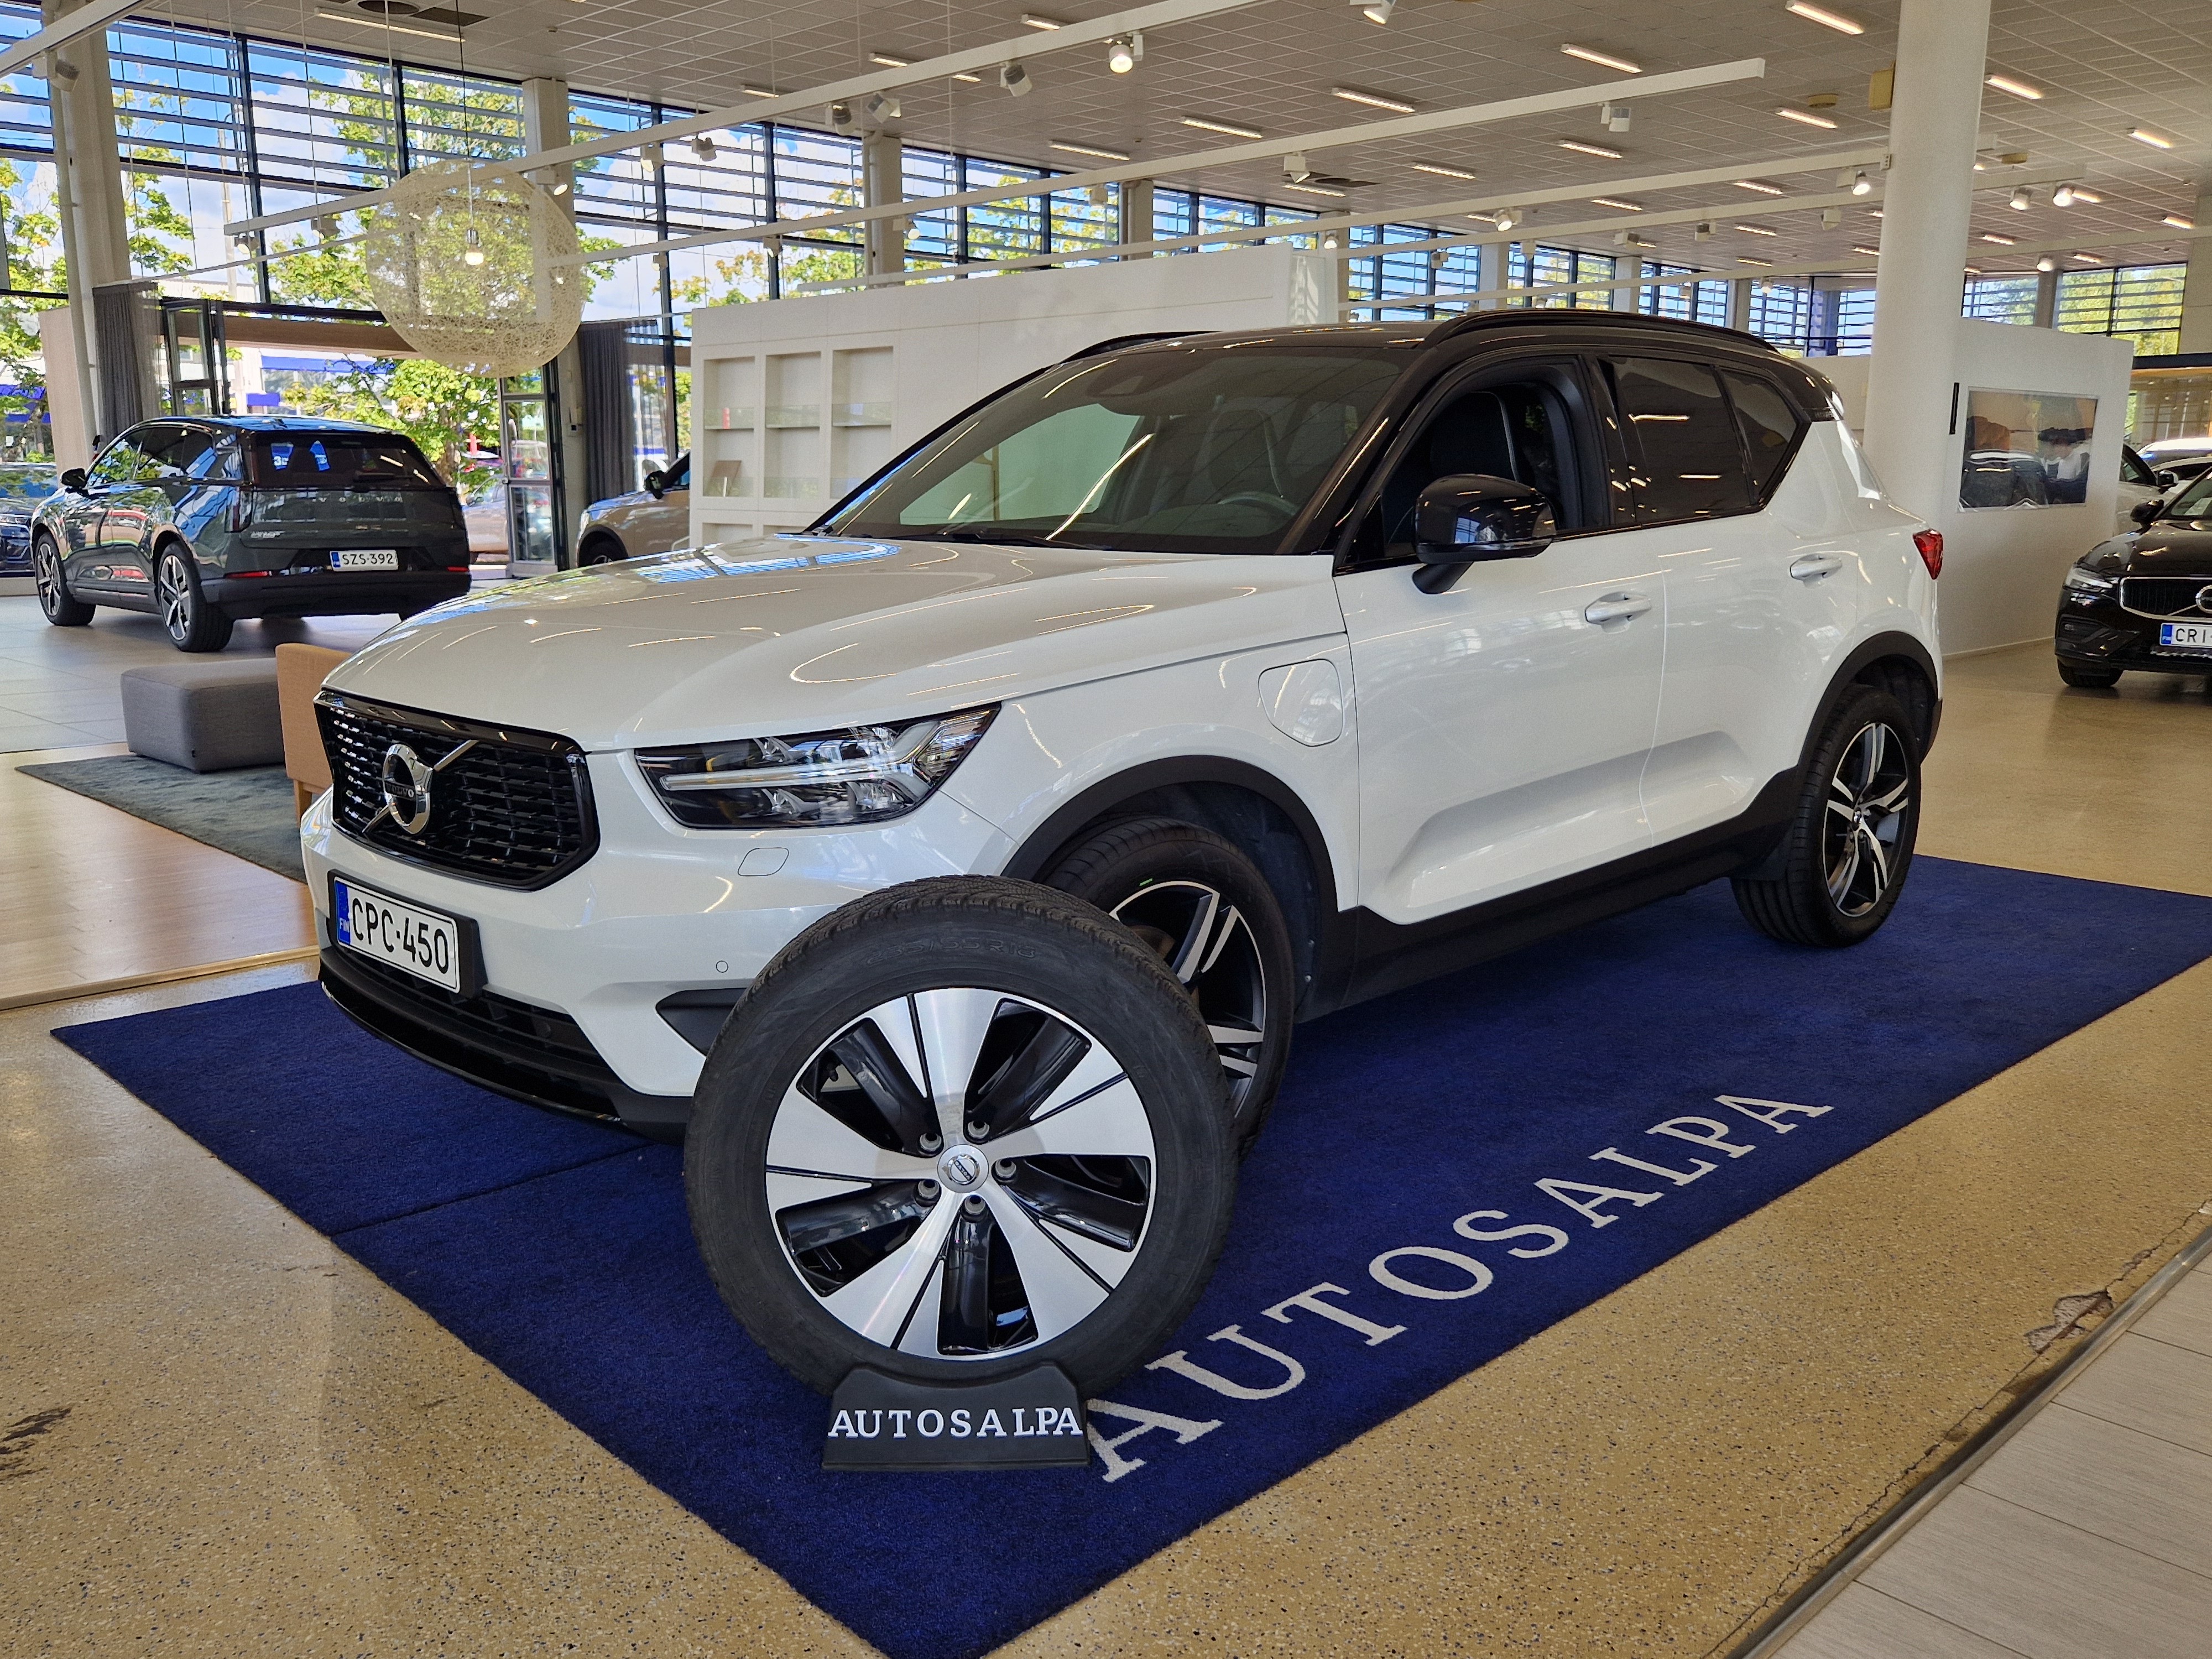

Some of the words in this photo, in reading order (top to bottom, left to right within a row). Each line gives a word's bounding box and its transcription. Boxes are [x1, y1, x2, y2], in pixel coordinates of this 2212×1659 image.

[342, 553, 394, 565] SZS-392
[385, 782, 415, 798] VOLVO
[339, 917, 350, 933] FIN
[352, 898, 449, 974] CPC-450
[1087, 1094, 1835, 1483] AUTOSALPA
[828, 1407, 1083, 1438] AUTOSALPA
